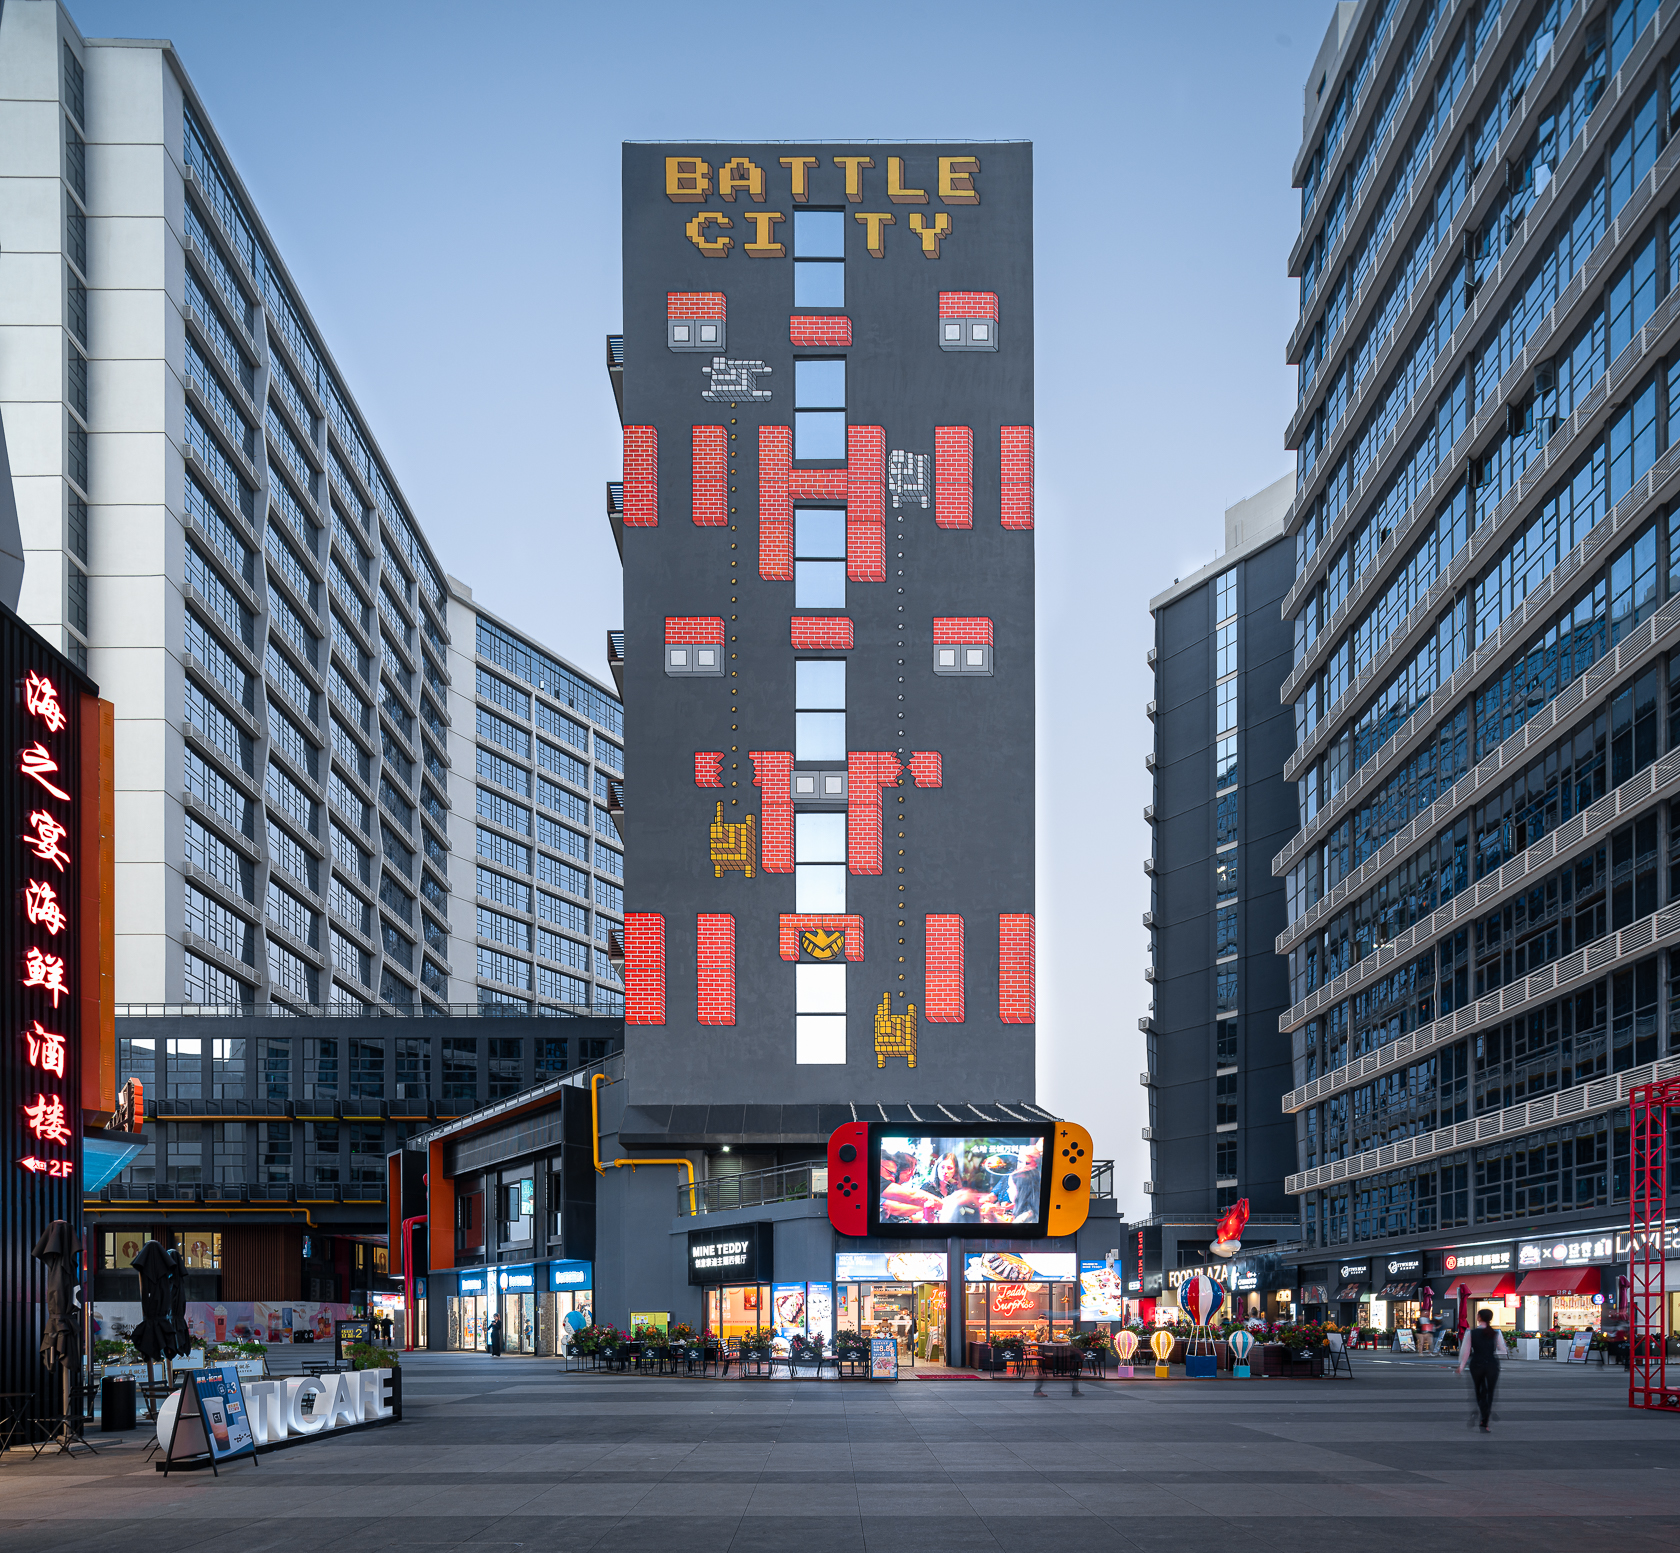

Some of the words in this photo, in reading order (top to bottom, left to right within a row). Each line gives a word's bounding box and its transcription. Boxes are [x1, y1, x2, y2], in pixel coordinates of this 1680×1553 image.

[665, 156, 981, 205] BATTLE
[685, 211, 953, 259] CITY
[18, 669, 72, 1147] 海之宴海鲜酒楼
[49, 1159, 73, 1178] 2F
[692, 1244, 716, 1258] MINE
[717, 1241, 749, 1255] TEDDY
[1169, 1270, 1193, 1288] FOOD
[998, 1284, 1028, 1302] Teddy
[992, 1297, 1035, 1317] Surprise
[355, 1328, 363, 1339] 2
